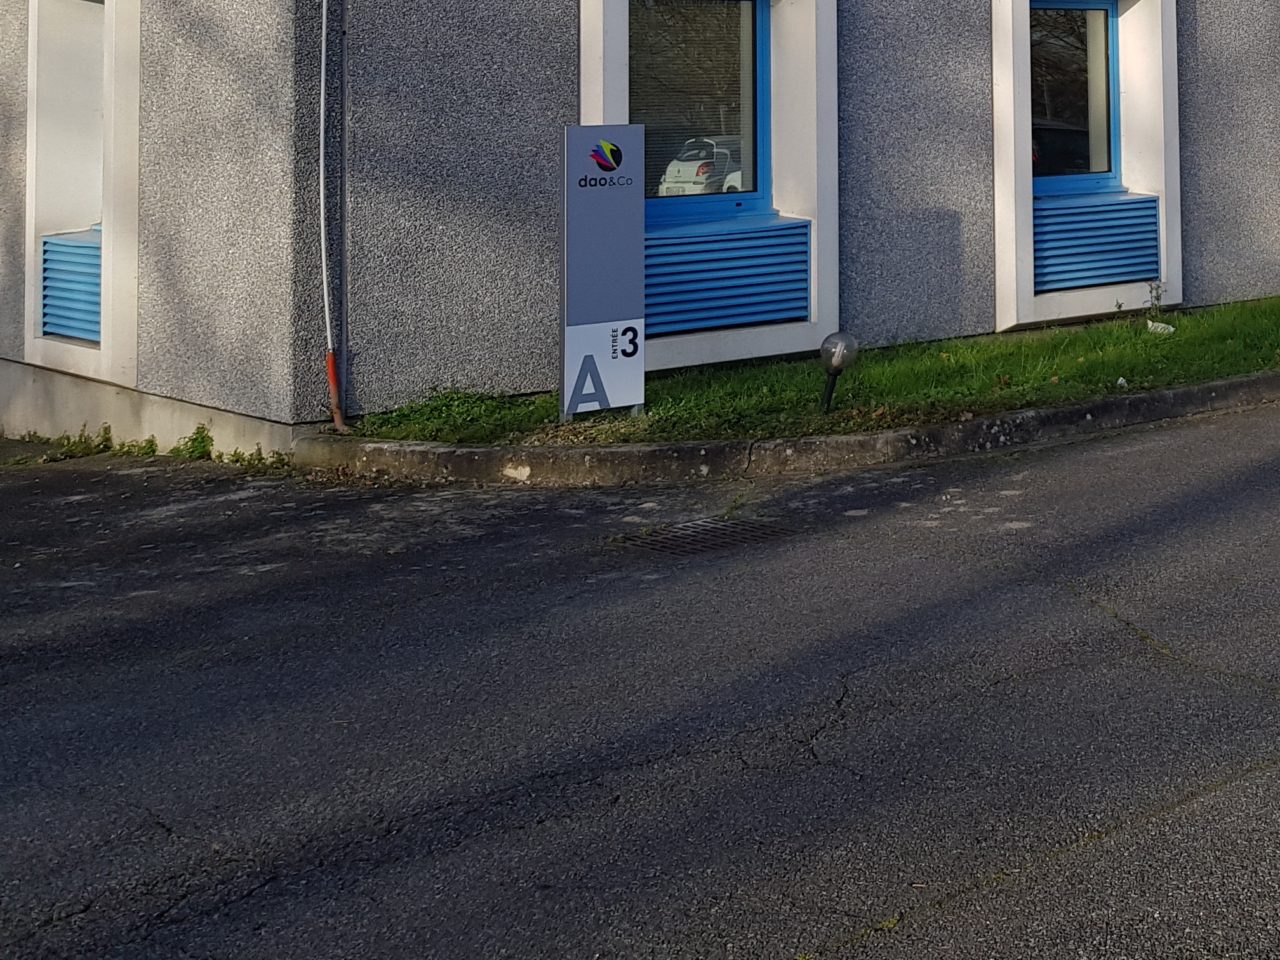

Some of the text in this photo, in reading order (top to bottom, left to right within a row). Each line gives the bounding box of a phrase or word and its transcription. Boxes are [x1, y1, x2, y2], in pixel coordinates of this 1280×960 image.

[578, 175, 633, 188] dao&Co
[620, 326, 639, 358] 3
[565, 354, 611, 415] A
